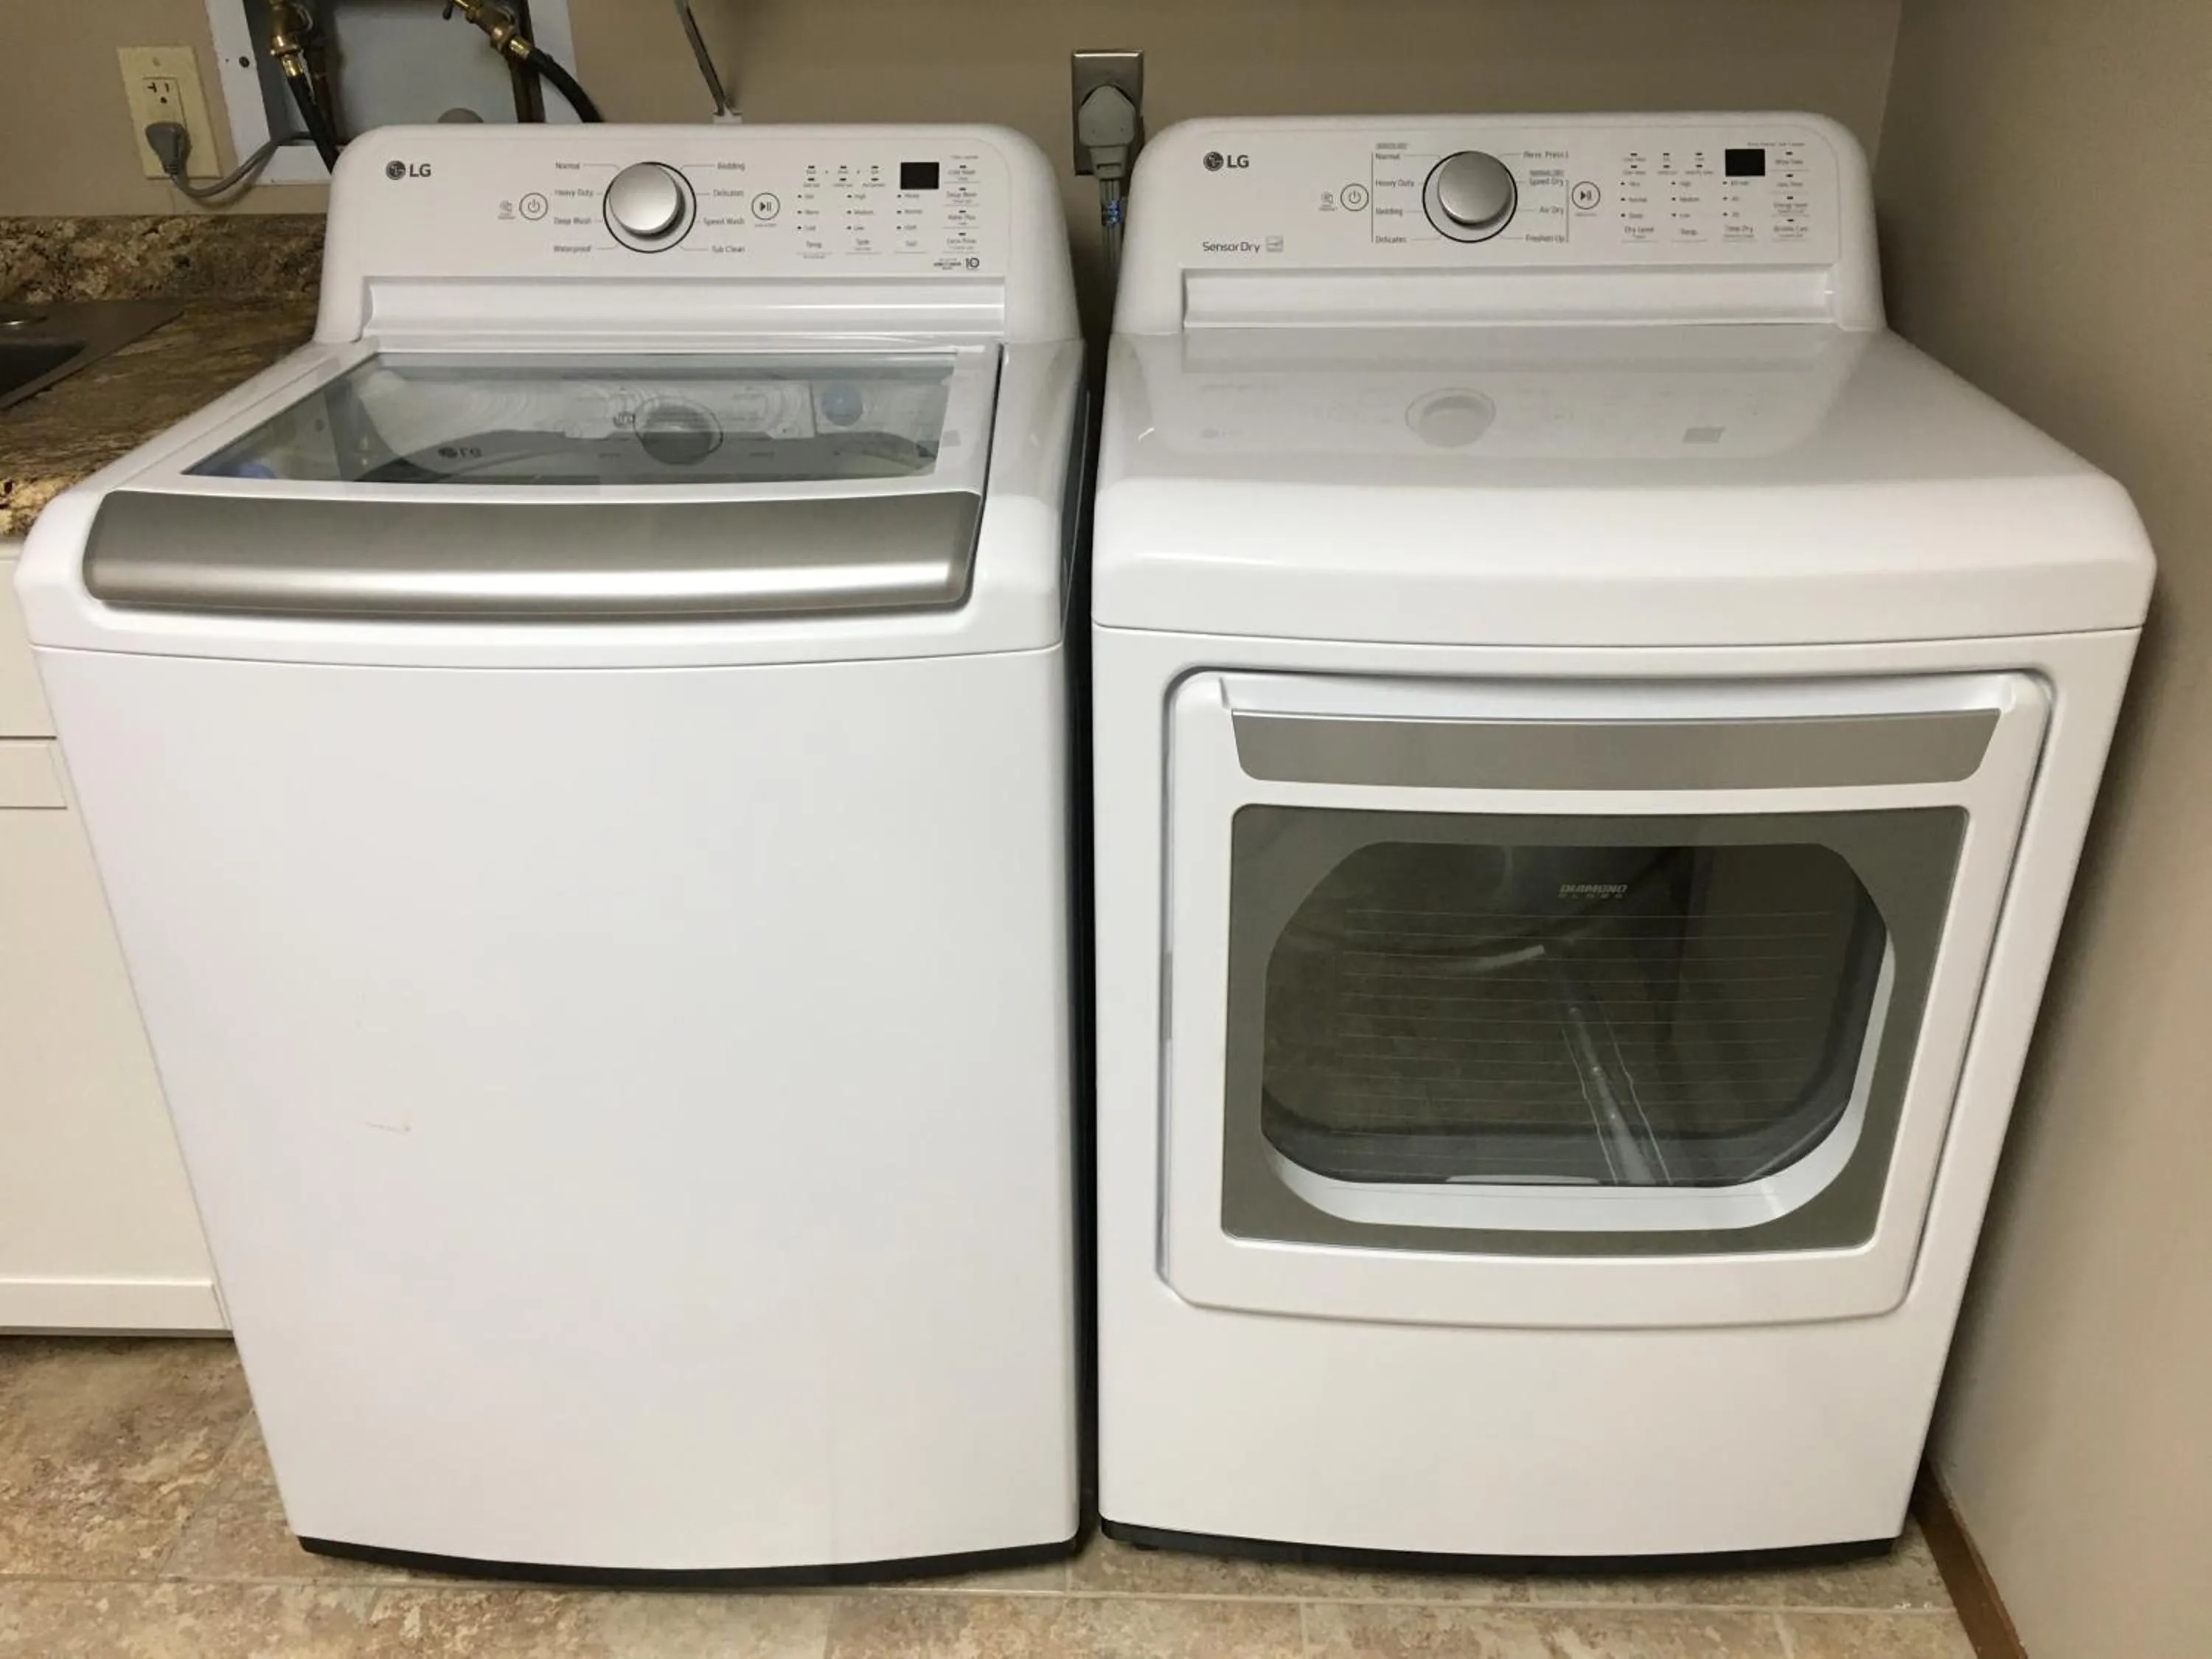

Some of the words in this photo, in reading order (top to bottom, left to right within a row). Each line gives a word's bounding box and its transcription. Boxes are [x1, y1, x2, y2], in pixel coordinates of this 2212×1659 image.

[1226, 154, 1250, 169] LG
[1374, 153, 1401, 161] Normal
[409, 163, 431, 178] LG
[555, 161, 580, 170] Normal
[1397, 178, 1415, 188] Duty
[577, 188, 594, 198] Duty
[1551, 205, 1565, 216] Dry
[726, 217, 745, 225] Wash
[712, 245, 725, 254] Tub
